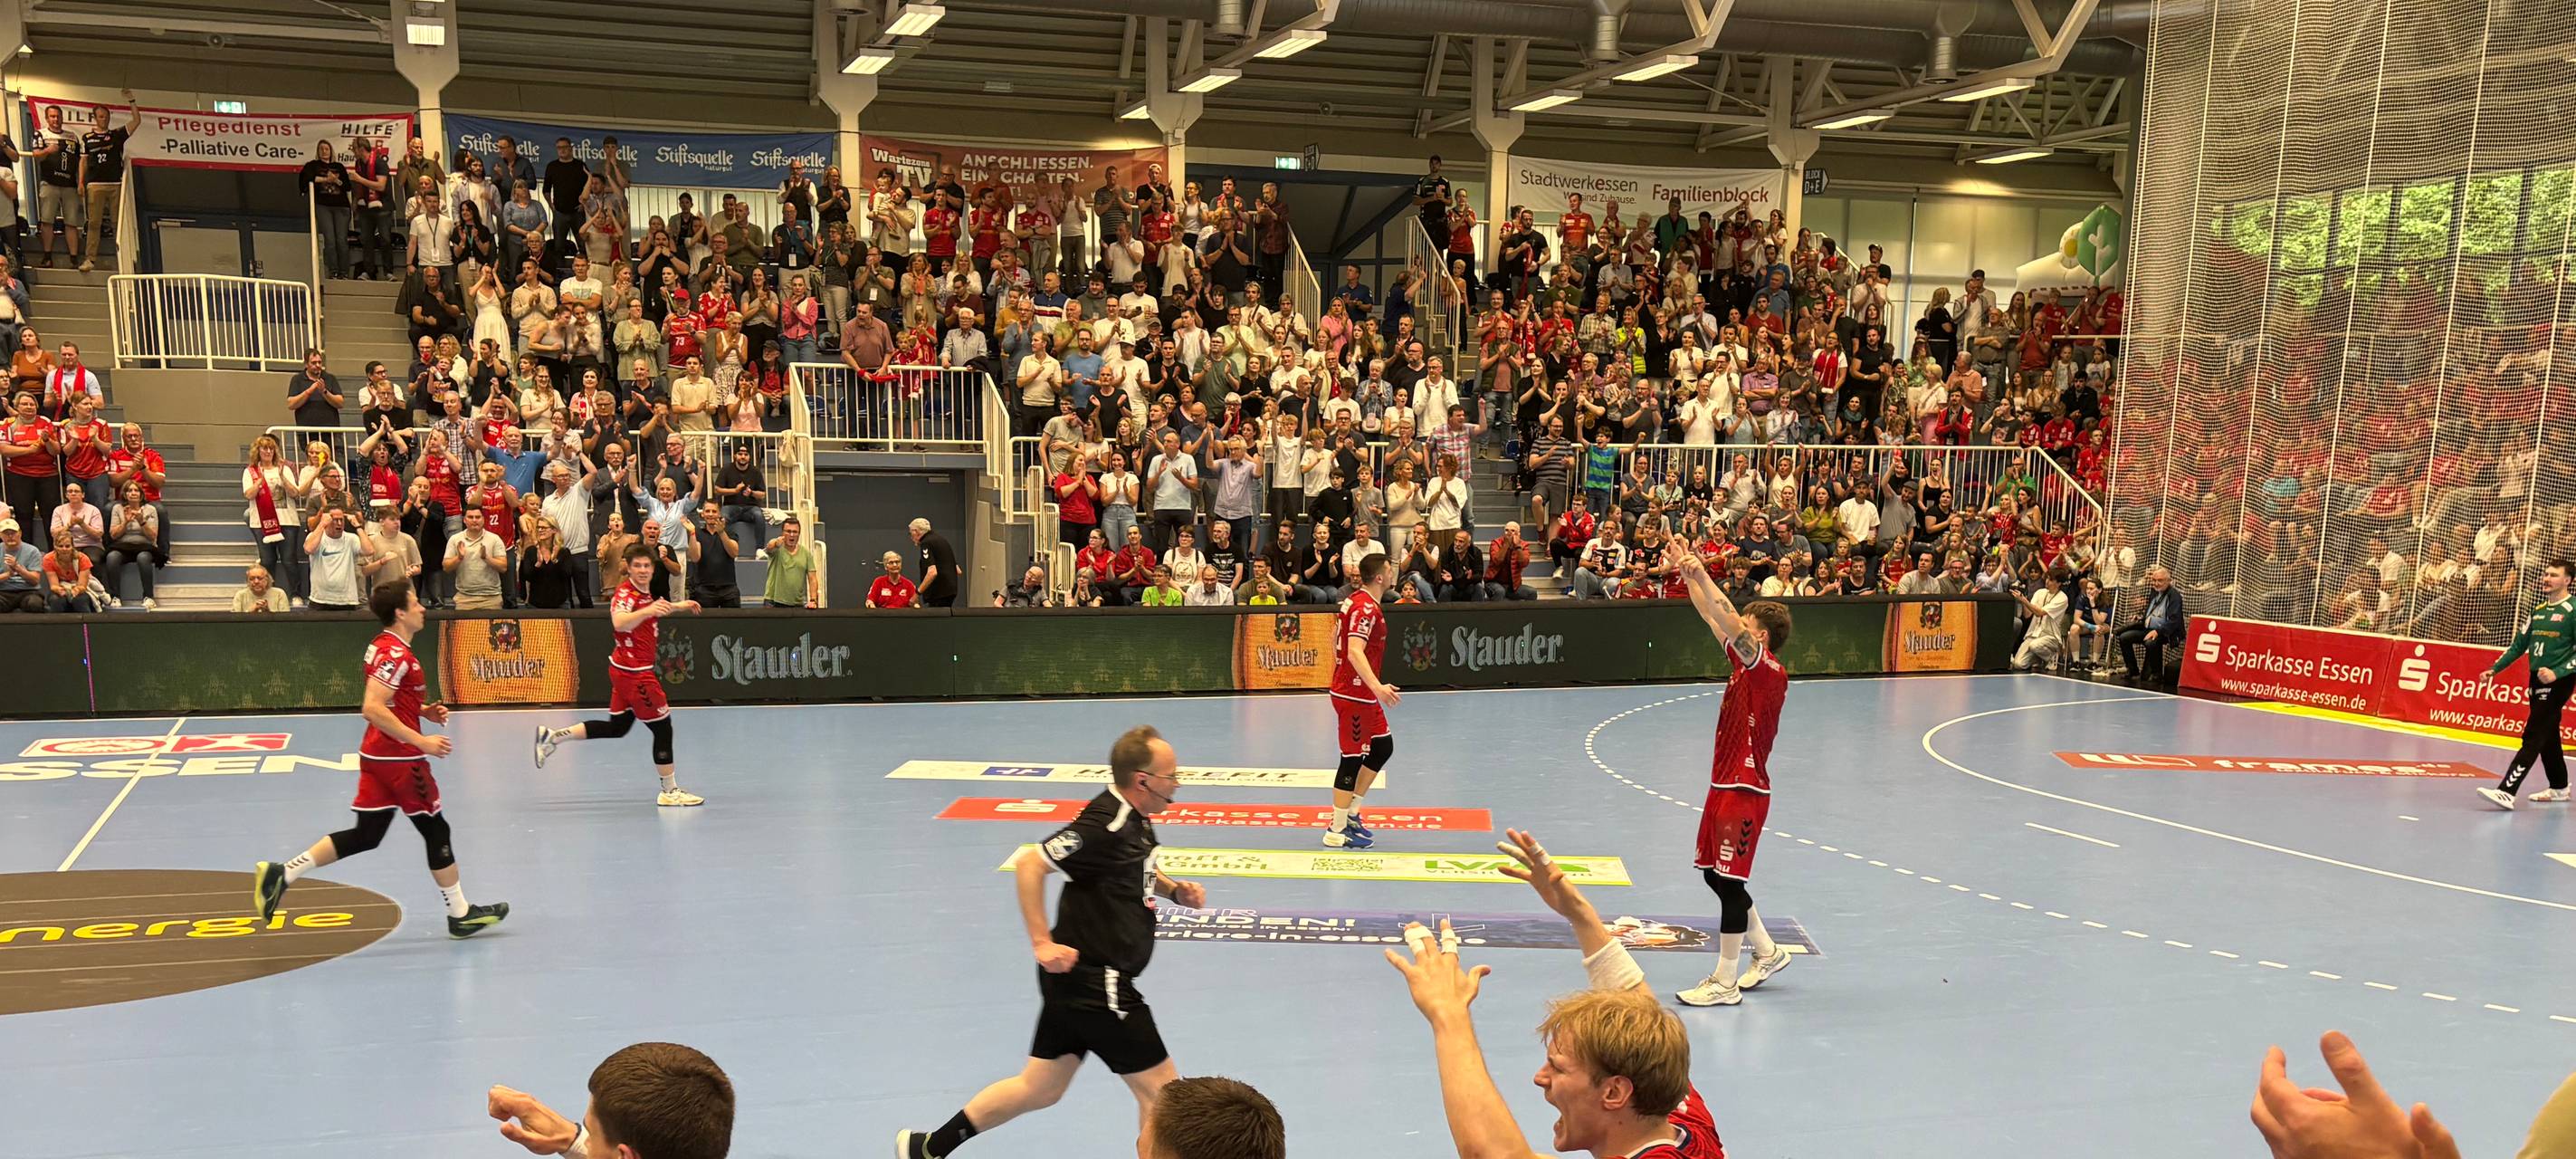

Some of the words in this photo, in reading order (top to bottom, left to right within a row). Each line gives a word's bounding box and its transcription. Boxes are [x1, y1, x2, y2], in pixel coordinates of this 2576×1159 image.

[67, 110, 95, 122] ILF
[157, 117, 301, 136] Pflegedienst
[341, 123, 393, 135] HILFE
[160, 139, 250, 157] -Palliative
[254, 143, 304, 158] Care-
[459, 133, 539, 156] Stiftselle
[655, 143, 733, 167] Stiftsquelle
[896, 164, 932, 187] TV
[961, 168, 1085, 184] EINCHATEN.
[1521, 169, 1638, 192] Stadtwerkessen
[1652, 184, 1769, 203] Familienblock
[675, 336, 685, 346] 73
[490, 514, 499, 525] 22
[1450, 623, 1564, 671] Stauder
[2533, 642, 2544, 656] 24
[711, 632, 851, 685] Stauder
[2225, 645, 2314, 677] Sparkasse
[2318, 657, 2373, 685] Essen
[2220, 678, 2367, 711] www.sparkasse-essen.de
[2436, 672, 2532, 705] Sparkass
[1149, 809, 1301, 819] rkasse
[1317, 812, 1443, 822] Esen
[1155, 915, 1356, 927] INDEN!
